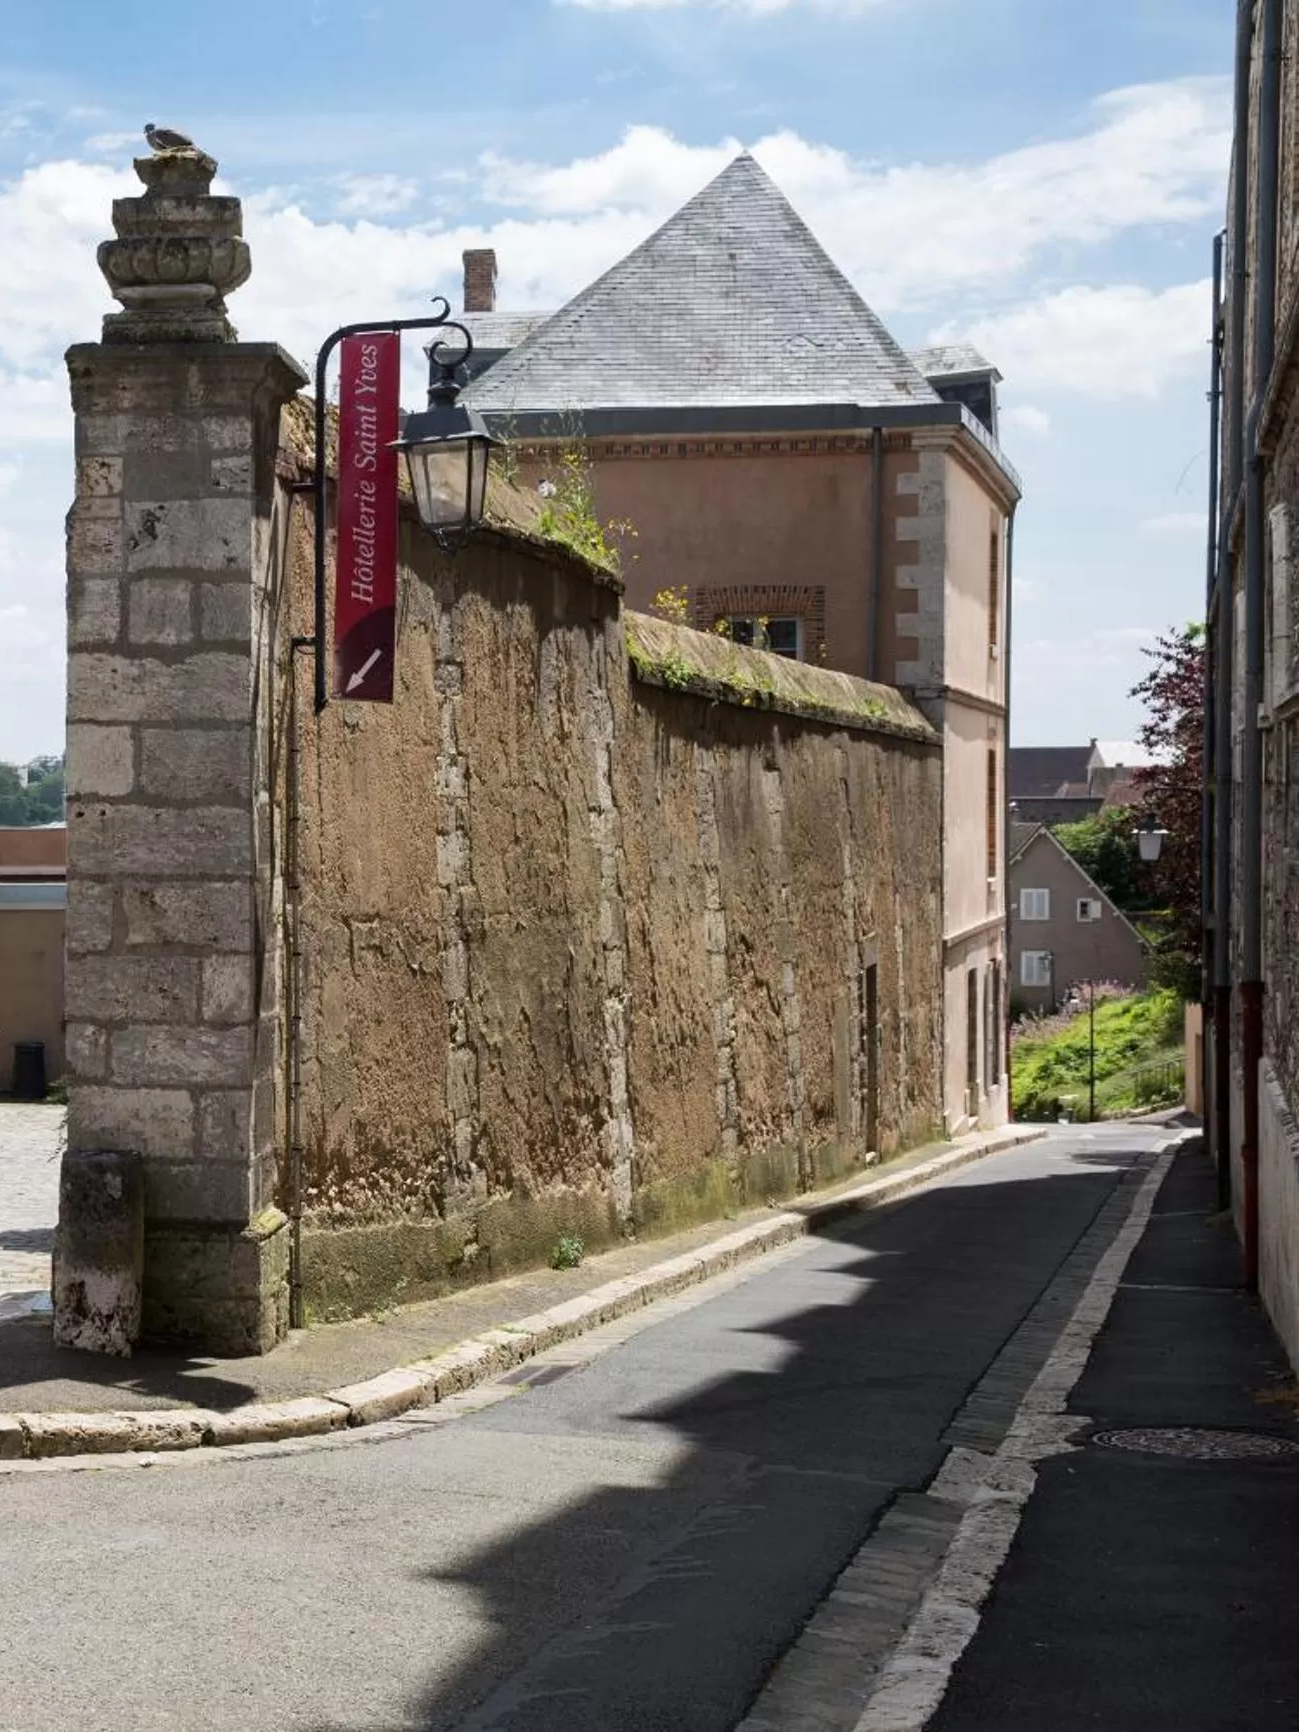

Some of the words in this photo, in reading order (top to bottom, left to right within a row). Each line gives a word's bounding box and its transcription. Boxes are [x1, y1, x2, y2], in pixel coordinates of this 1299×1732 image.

[354, 344, 378, 394] Yves
[354, 406, 377, 472] Saint
[351, 481, 376, 605] Hôtellerie
